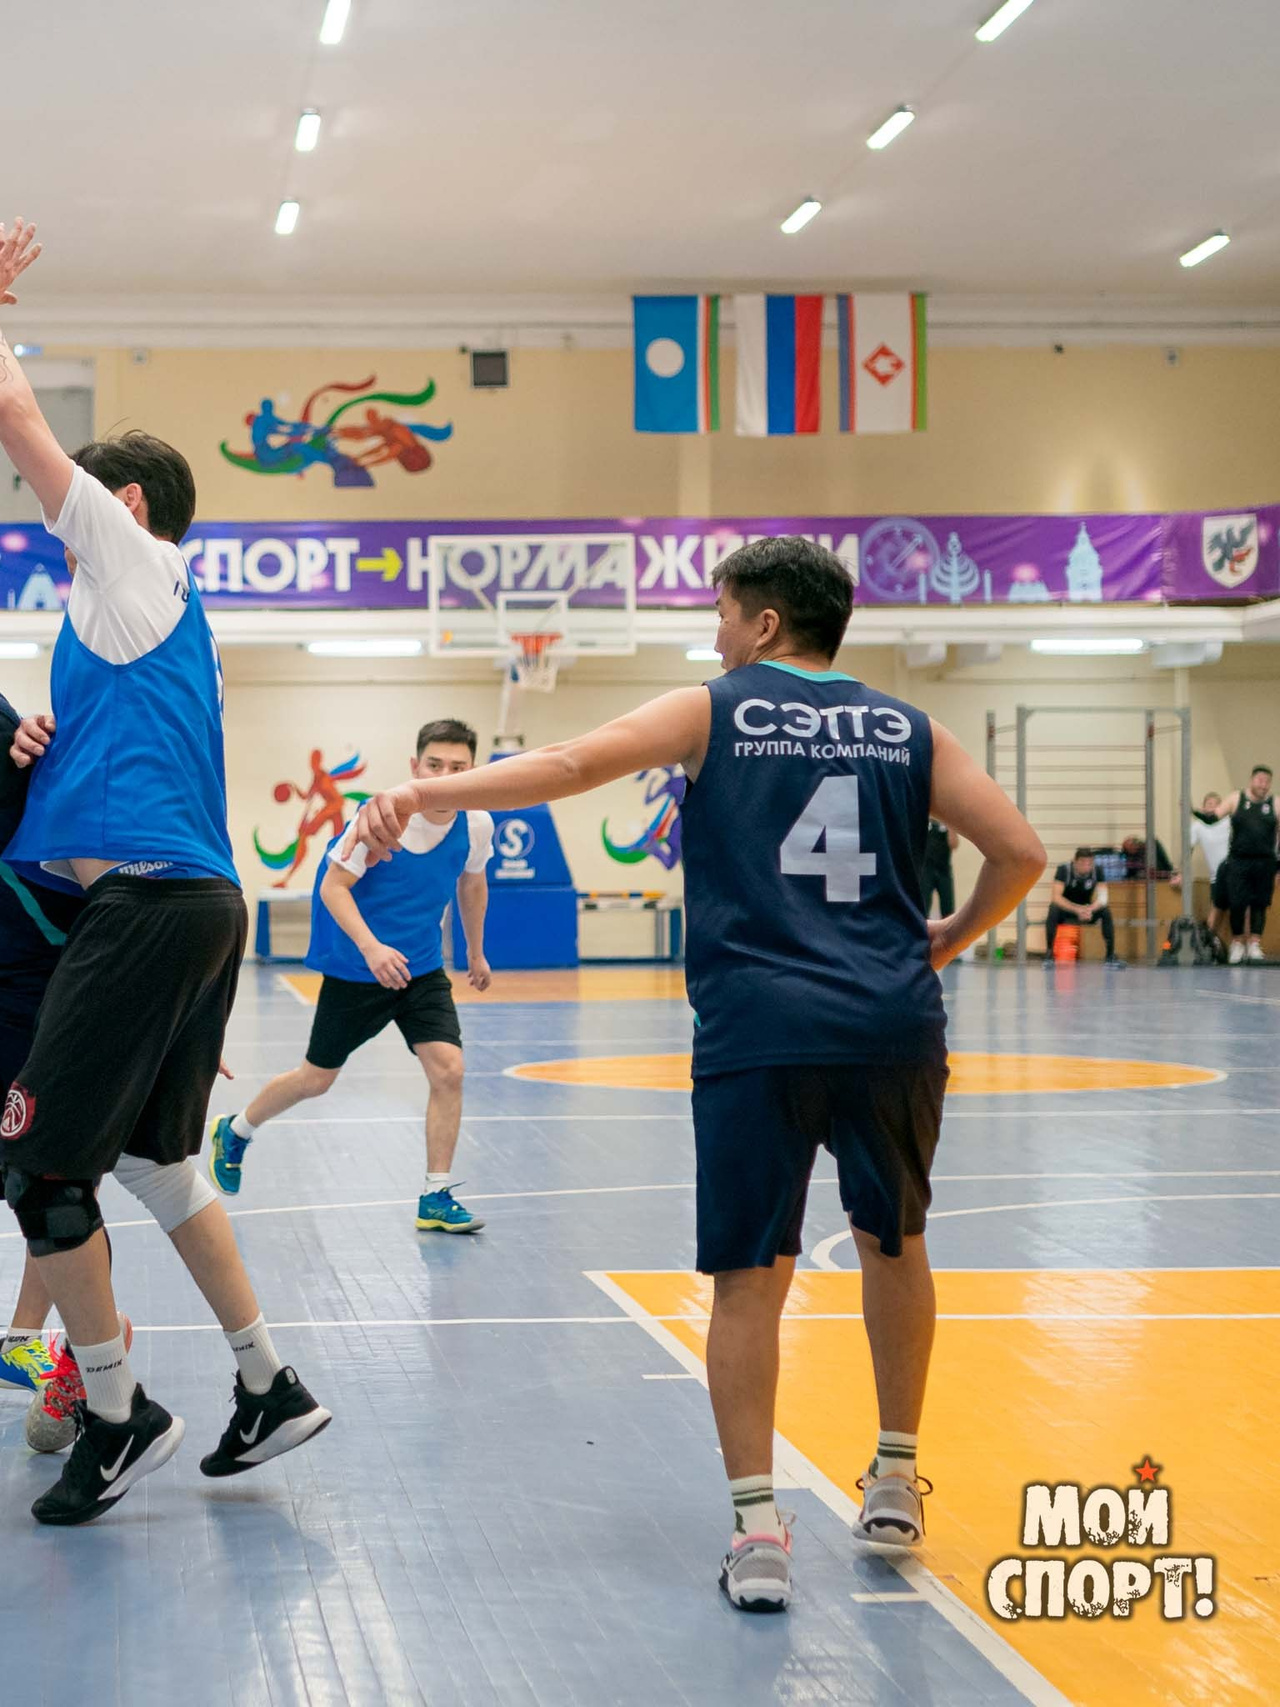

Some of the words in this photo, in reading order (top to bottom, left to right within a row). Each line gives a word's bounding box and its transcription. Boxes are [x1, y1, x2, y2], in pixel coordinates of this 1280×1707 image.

[181, 537, 360, 593] СПОРТ
[407, 536, 630, 591] НОРМА
[733, 698, 912, 743] СЭТТЭ
[734, 740, 806, 758] ГРУППА
[811, 743, 911, 767] КОМПАНИЙ
[779, 774, 877, 903] 4
